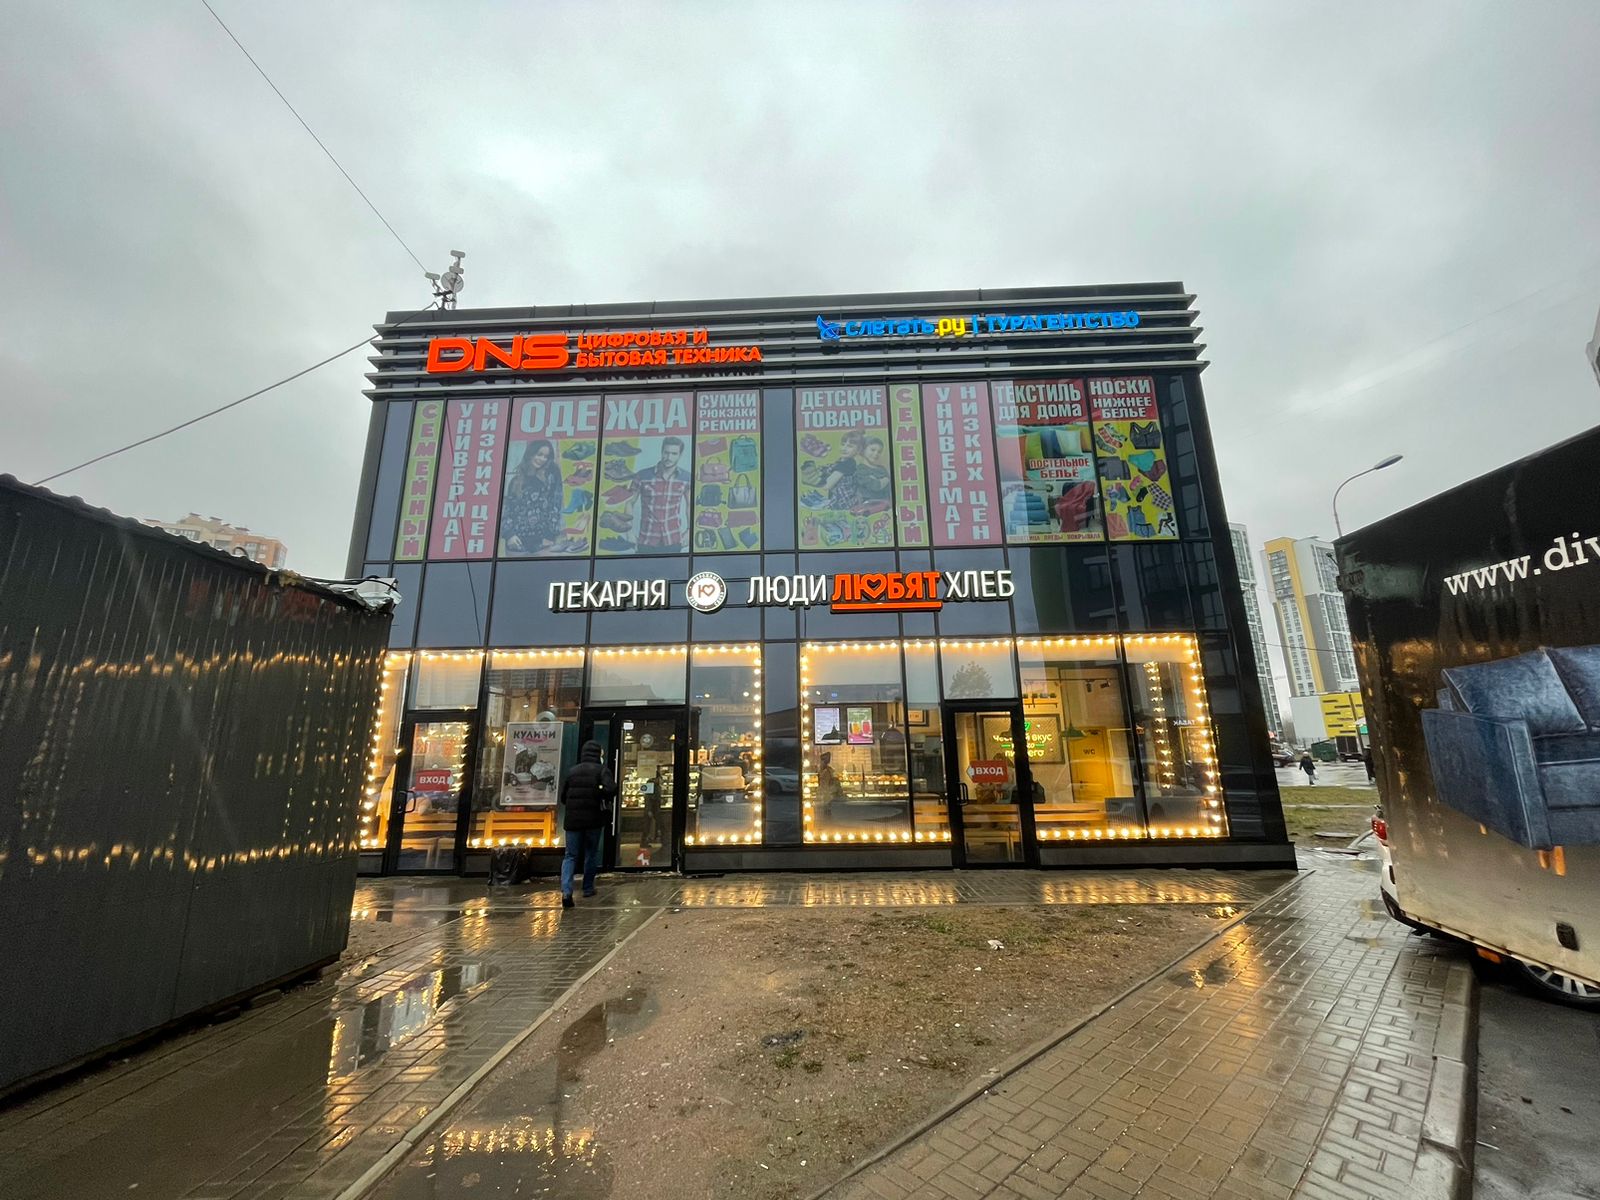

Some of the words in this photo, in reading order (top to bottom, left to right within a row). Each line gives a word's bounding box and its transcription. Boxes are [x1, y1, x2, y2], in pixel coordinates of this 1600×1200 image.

[985, 311, 1140, 333] ТУРАГЕНТСТВО
[578, 331, 687, 350] ЦИФРОВАЯ
[693, 331, 708, 344] И
[427, 334, 569, 373] DNS
[577, 350, 666, 368] БЫТОВАЯ
[672, 347, 762, 364] ТЕХНИКА
[995, 384, 1081, 403] ТЕКСТИЛЬ
[1090, 379, 1150, 395] НОСКИ
[700, 393, 757, 409] СУМКИ
[801, 389, 881, 410] ДЕТСКИЕ
[1093, 397, 1152, 408] НИЖНЕЕ
[520, 398, 688, 437] ОДЕЖДА
[700, 408, 757, 418] РЮКЗАКИ
[801, 409, 881, 428] ТОВАРЫ
[700, 419, 757, 431] РЕМНИ
[960, 386, 984, 481] НИЗКИХ
[473, 402, 499, 496] НИЗКИХ
[896, 388, 924, 542] СЕМЕЙНЫЙ
[936, 387, 963, 540] УНИВЕРМАГ
[1029, 458, 1090, 469] ПОСТЕЛЬНОЕ
[402, 404, 438, 556] СЕМЕЙНЫЙ
[443, 403, 474, 553] УНИВЕРМАГ
[969, 491, 990, 540] ЦЕН
[467, 505, 488, 553] ЦЕН
[548, 579, 666, 608] ПЕКАРНЯ
[747, 574, 827, 605] ЛЮДИ
[831, 572, 940, 600] ЛЮБЯТ
[945, 570, 1015, 598] ХЛЕБ
[513, 730, 556, 739] КУЛИЧИ
[419, 776, 446, 785] ВХОД
[975, 766, 1004, 776] ВХОД
